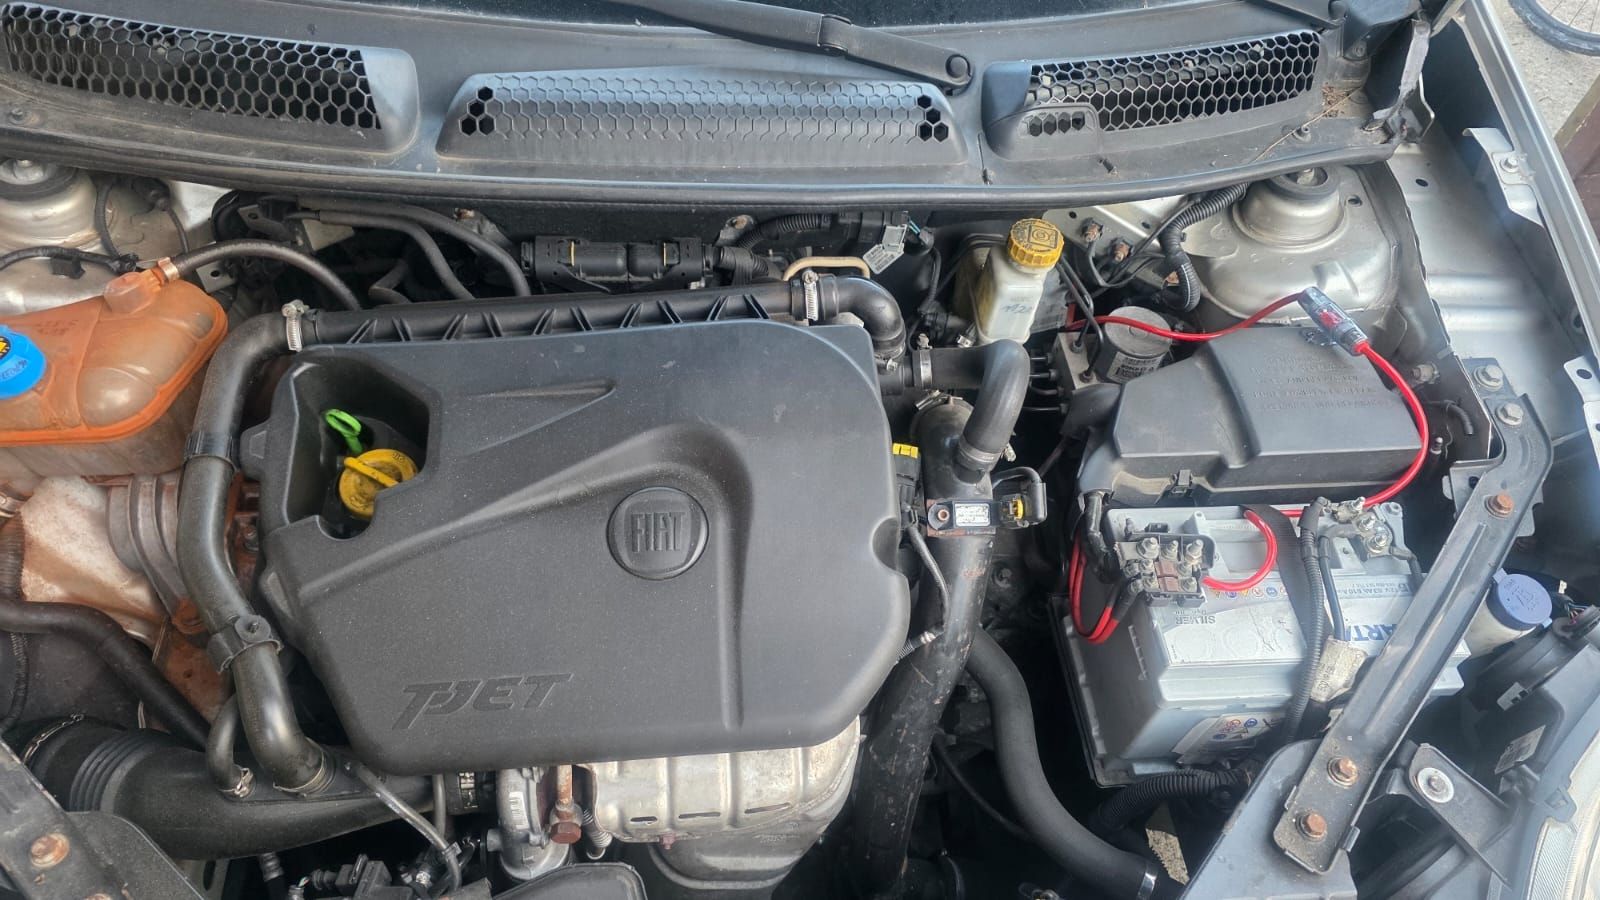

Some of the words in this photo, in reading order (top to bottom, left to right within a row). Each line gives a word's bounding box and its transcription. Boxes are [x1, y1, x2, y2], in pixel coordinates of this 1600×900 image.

[631, 511, 685, 553] FIAT
[1175, 615, 1216, 625] SILVER
[1344, 624, 1397, 641] ART
